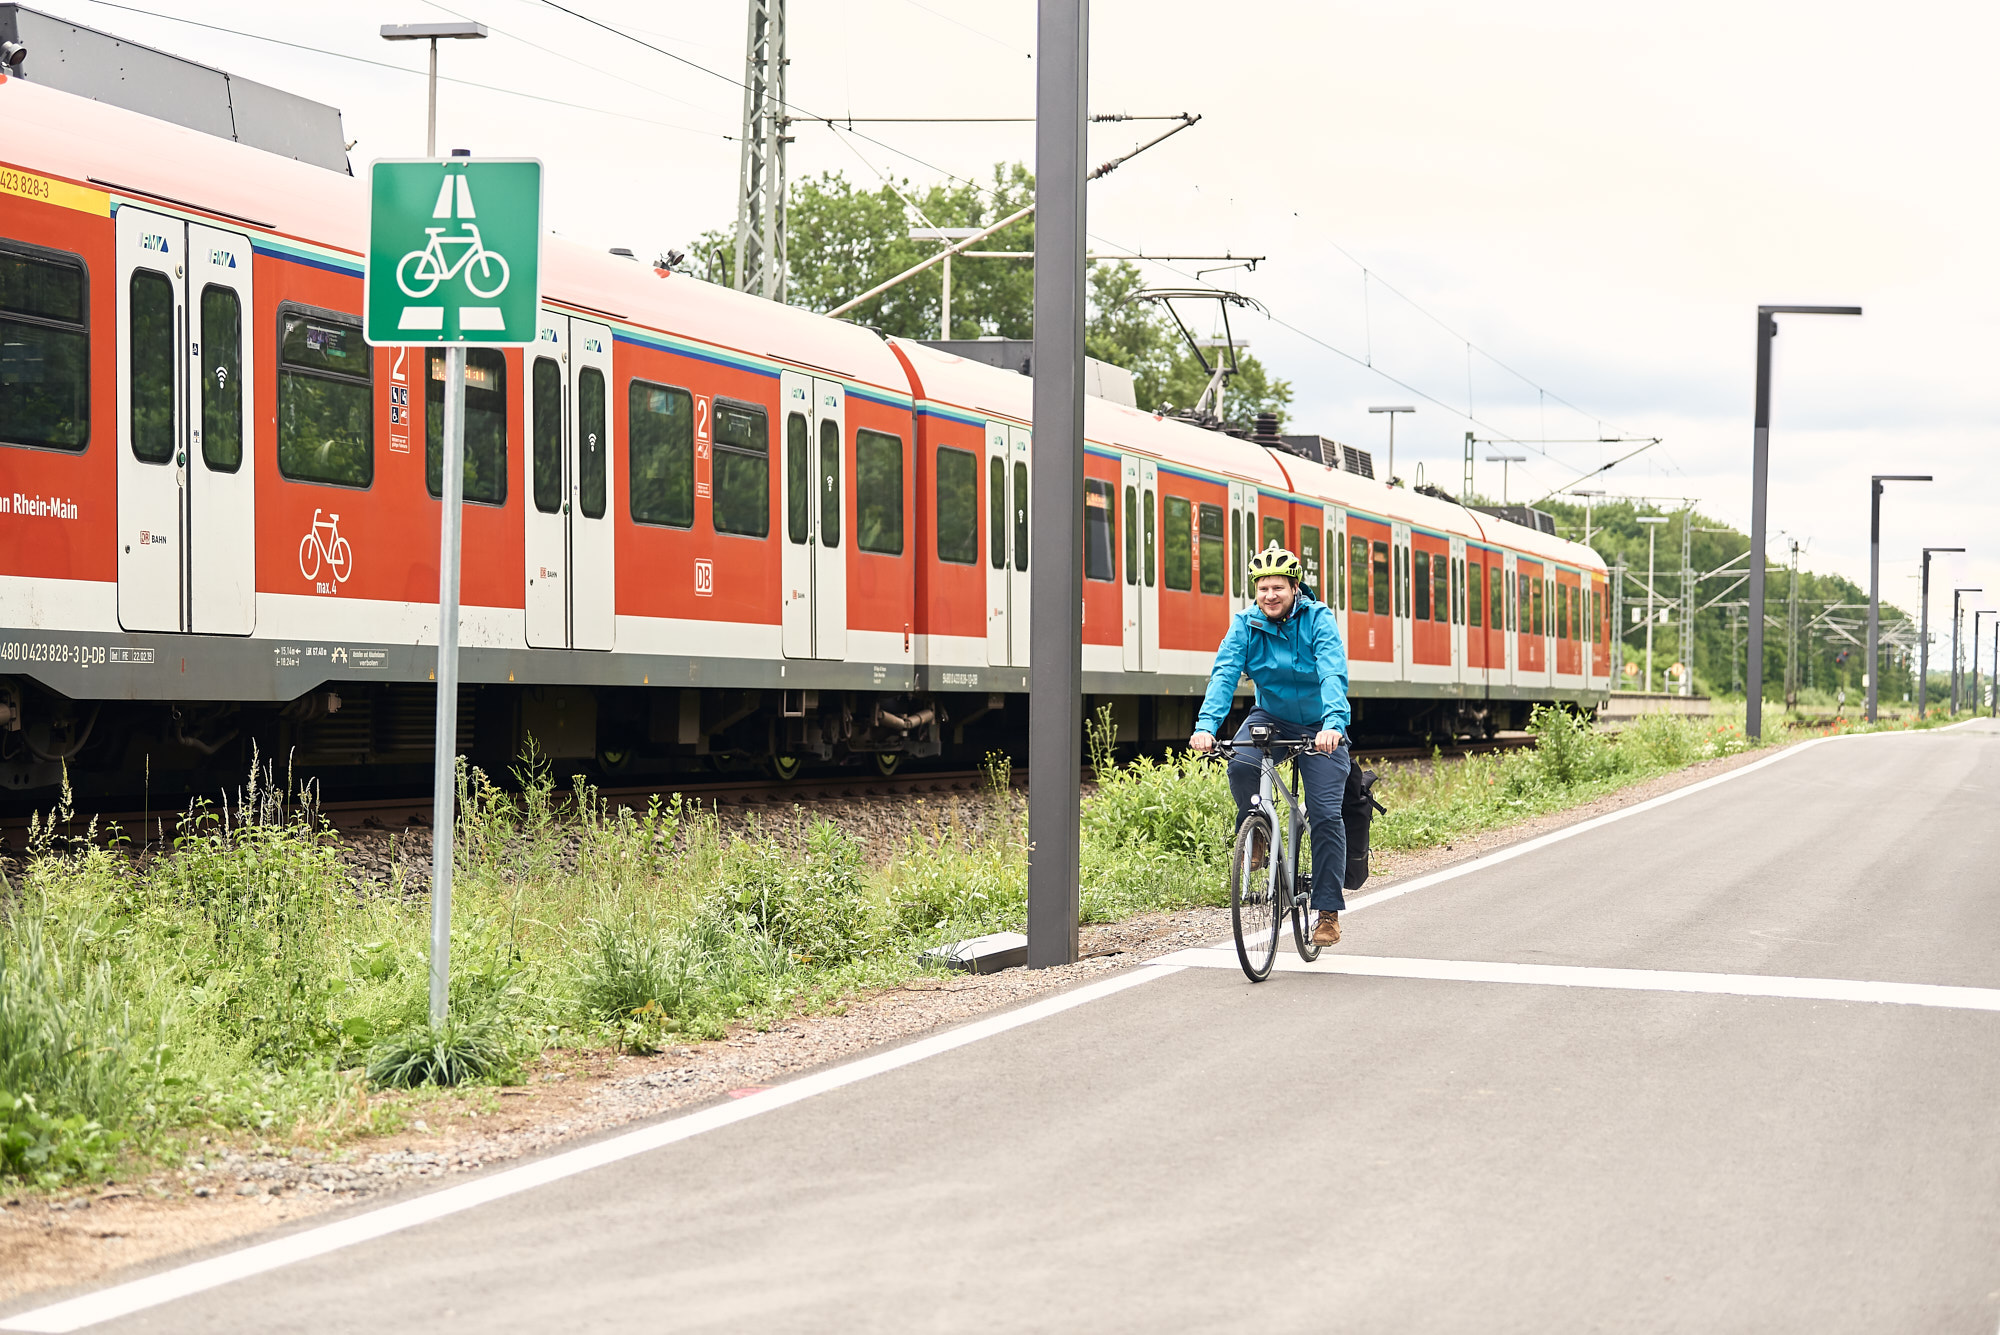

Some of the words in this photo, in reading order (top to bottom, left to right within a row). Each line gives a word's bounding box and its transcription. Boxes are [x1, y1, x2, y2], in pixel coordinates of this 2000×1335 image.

[0, 171, 18, 191] 423
[21, 176, 48, 198] 828-3
[391, 347, 405, 381] 2
[698, 399, 708, 439] 2
[13, 493, 78, 520] Rhein-Main
[1192, 505, 1198, 531] 2
[151, 535, 167, 544] BAHN
[696, 563, 712, 592] DB
[49, 644, 80, 663] 828-3
[81, 646, 106, 666] D-DB
